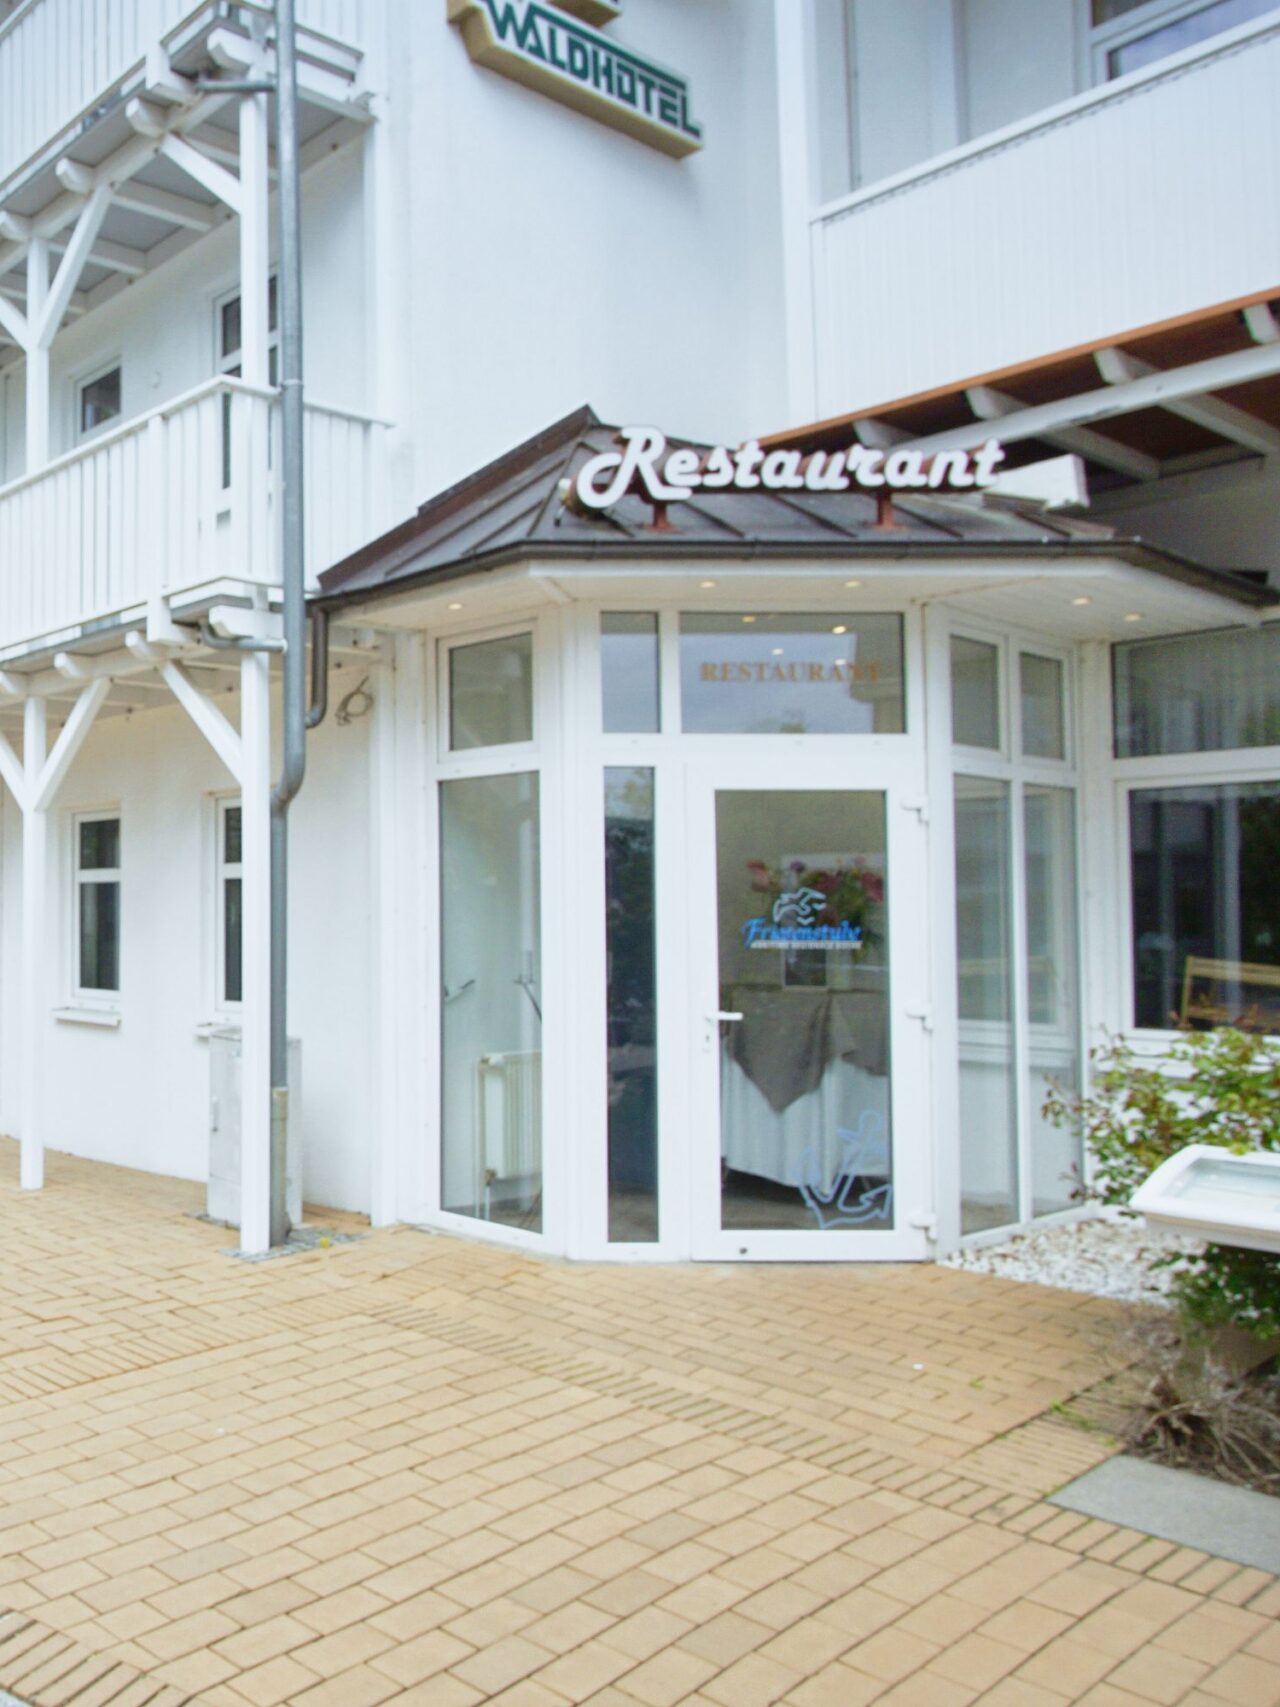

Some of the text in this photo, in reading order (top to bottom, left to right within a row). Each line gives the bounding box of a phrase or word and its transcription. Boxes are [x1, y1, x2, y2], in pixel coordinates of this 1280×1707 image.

[487, 0, 700, 138] WALDHOTEL
[576, 426, 1004, 508] Restaurant
[700, 660, 882, 683] RESTAURANT
